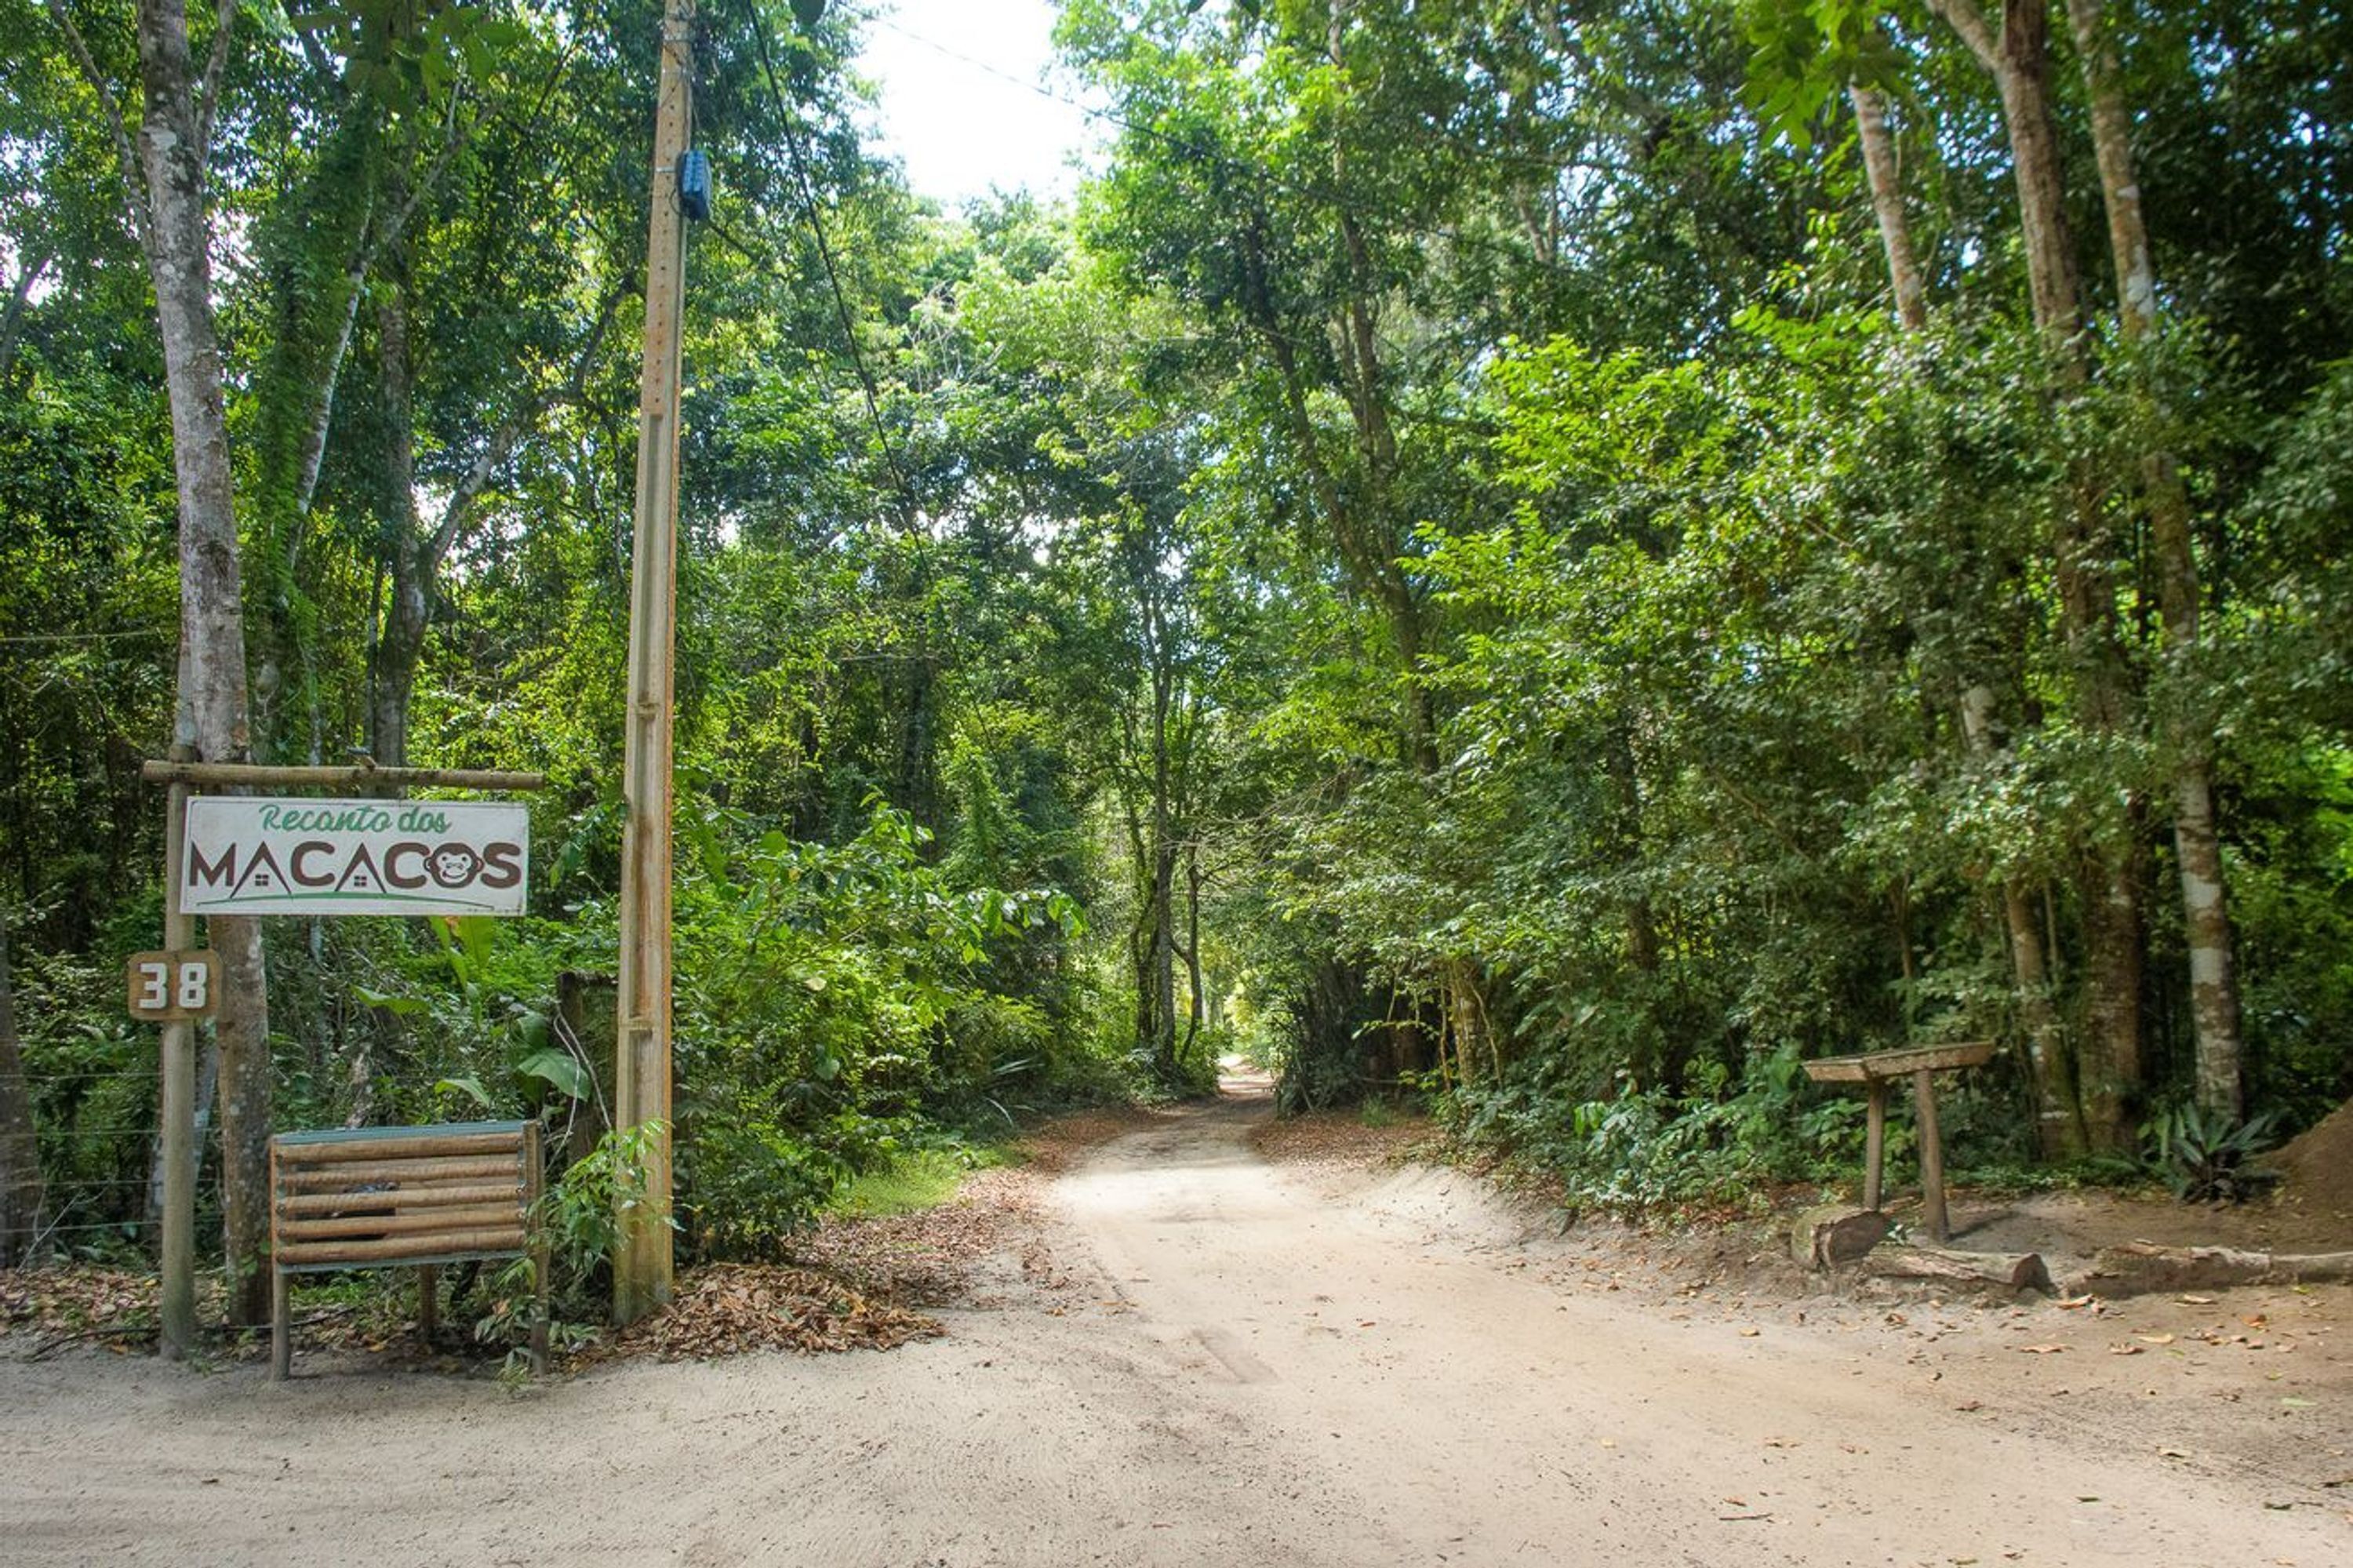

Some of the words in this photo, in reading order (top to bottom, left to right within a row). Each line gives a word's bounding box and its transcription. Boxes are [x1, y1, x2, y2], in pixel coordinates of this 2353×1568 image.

[259, 804, 394, 834] Recanto
[398, 804, 453, 834] dos
[189, 840, 521, 897] MACACOS
[139, 962, 208, 1010] 38
